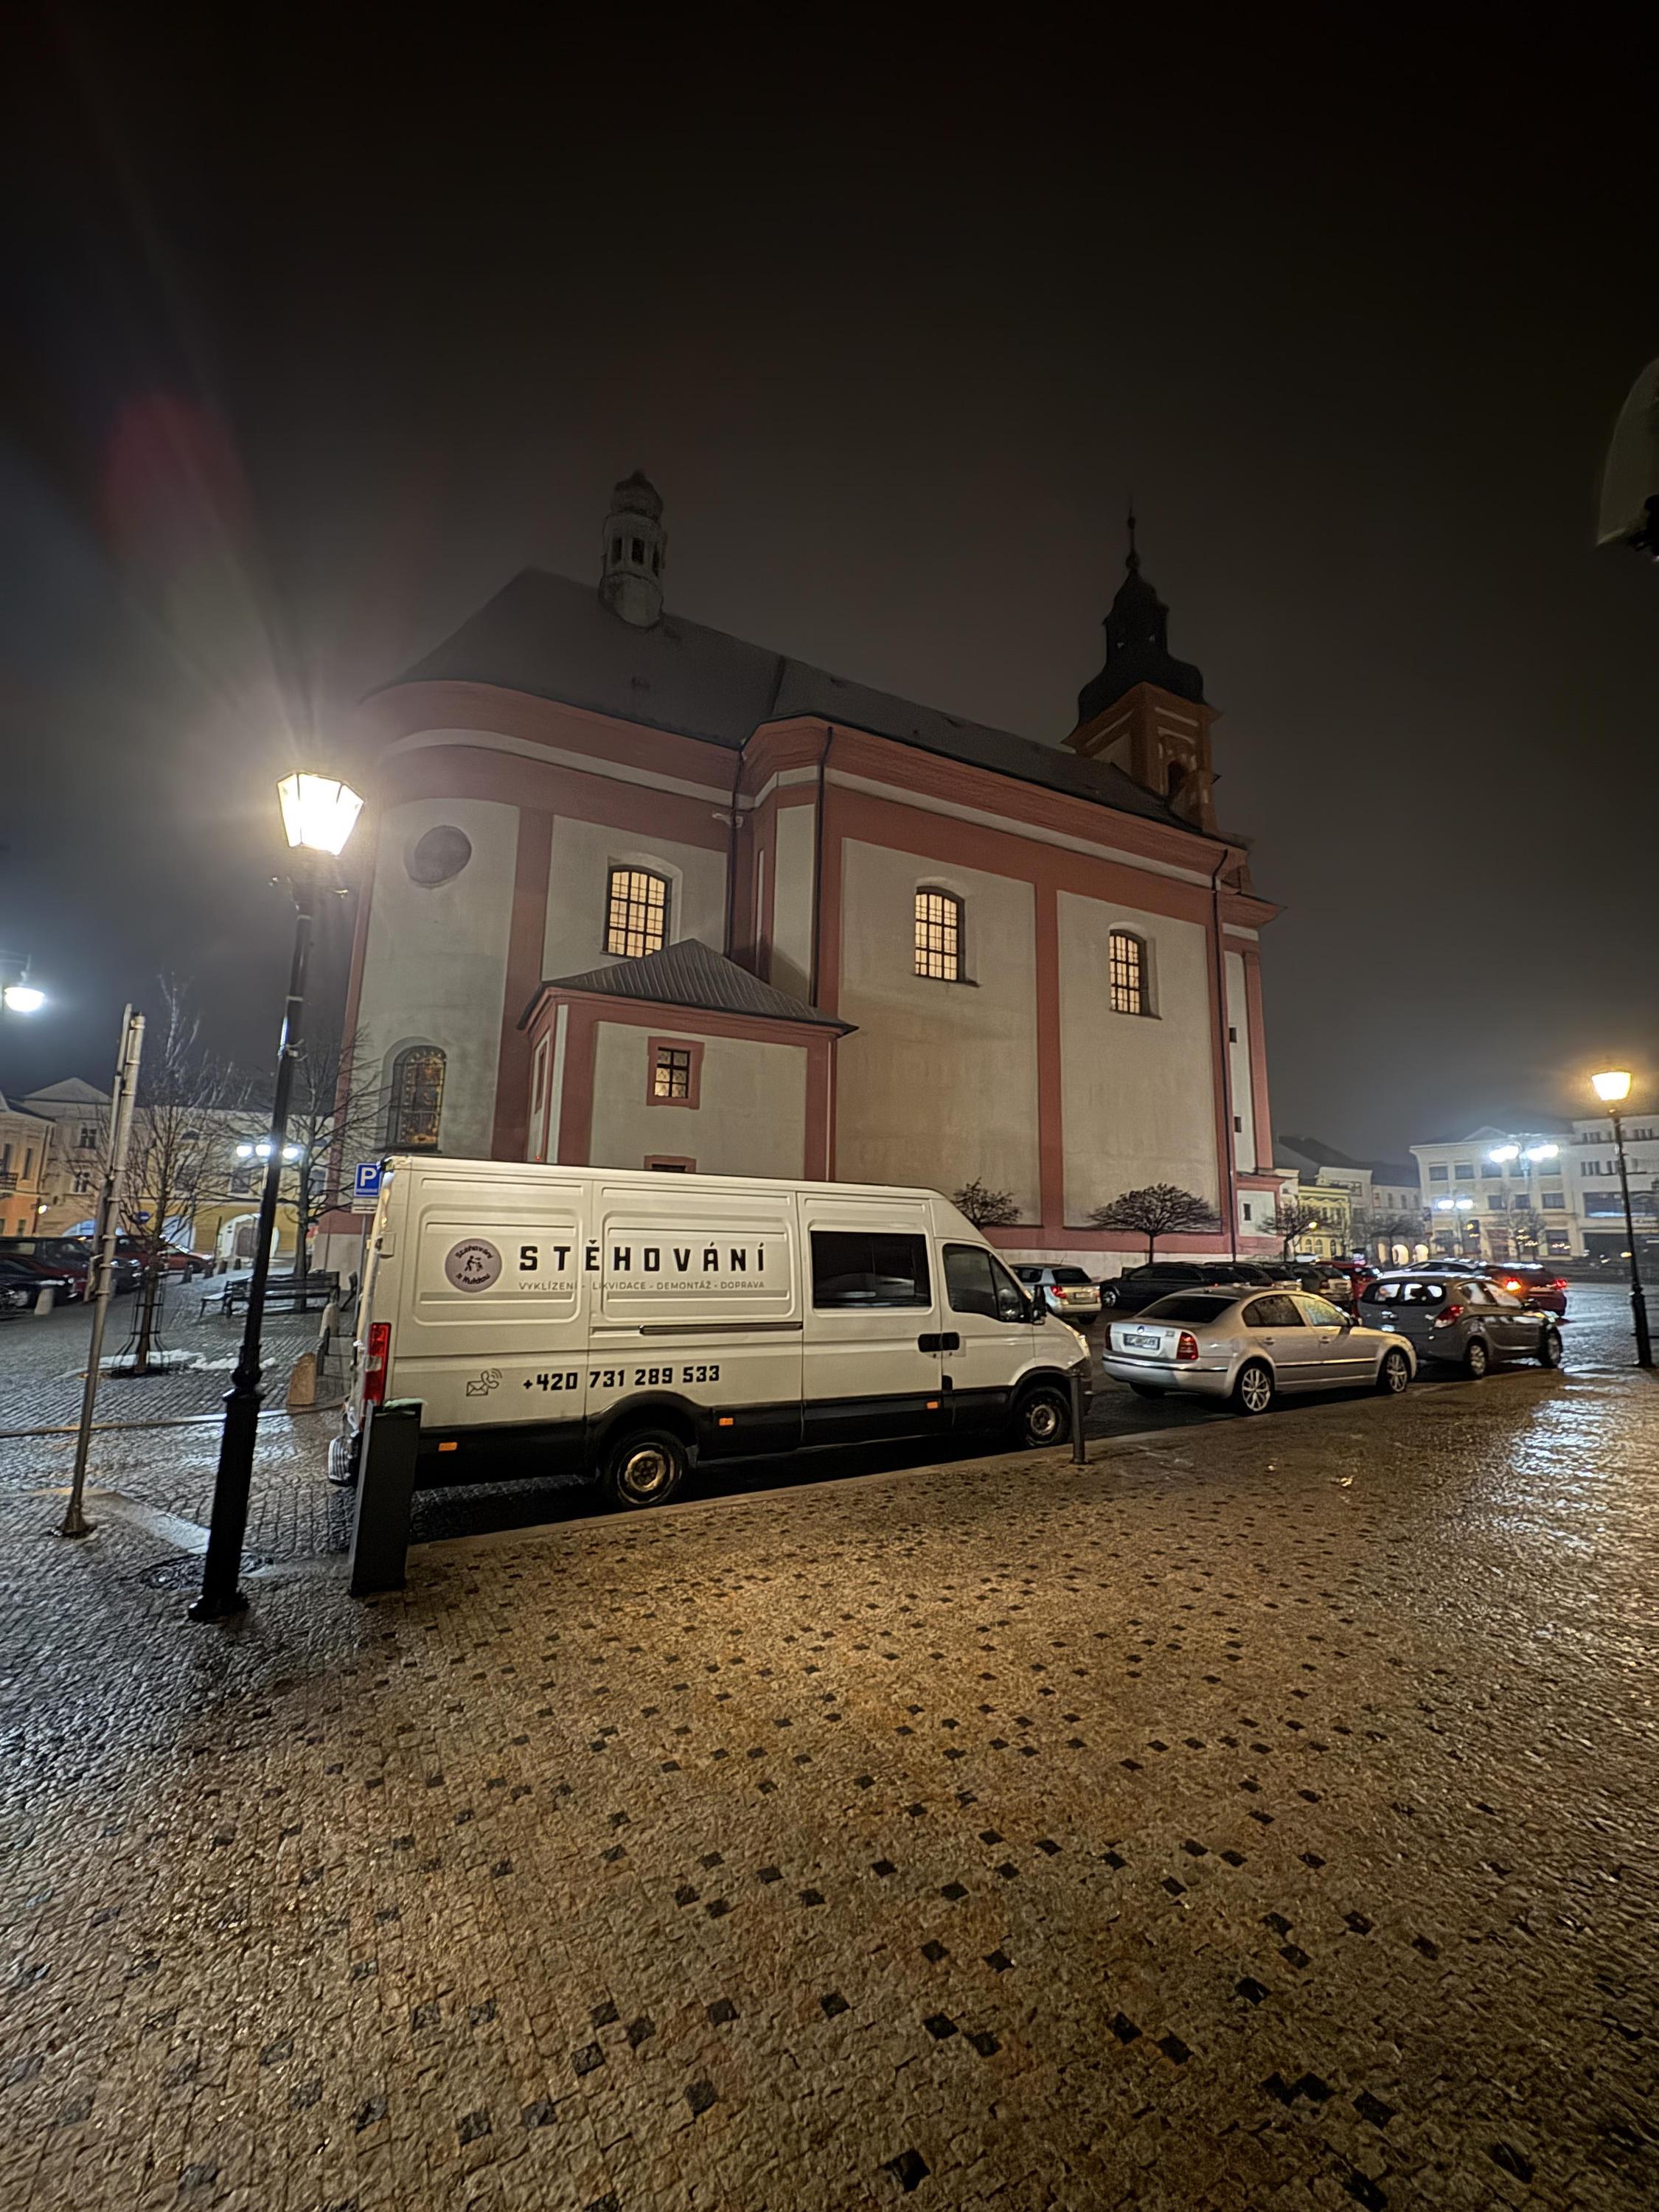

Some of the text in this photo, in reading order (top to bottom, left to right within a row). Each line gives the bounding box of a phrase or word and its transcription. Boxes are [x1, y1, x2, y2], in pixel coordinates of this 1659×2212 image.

[360, 1167, 377, 1186] P
[519, 1239, 764, 1271] STĚHOVÁNÍ
[519, 1280, 578, 1290] VYKLÍZENÍ
[592, 1281, 647, 1290] LIKVIDACE
[656, 1281, 712, 1290] DEMONTÁŽ
[720, 1281, 765, 1290] DOPRAVA
[523, 1365, 720, 1391] +420 731 289 533
